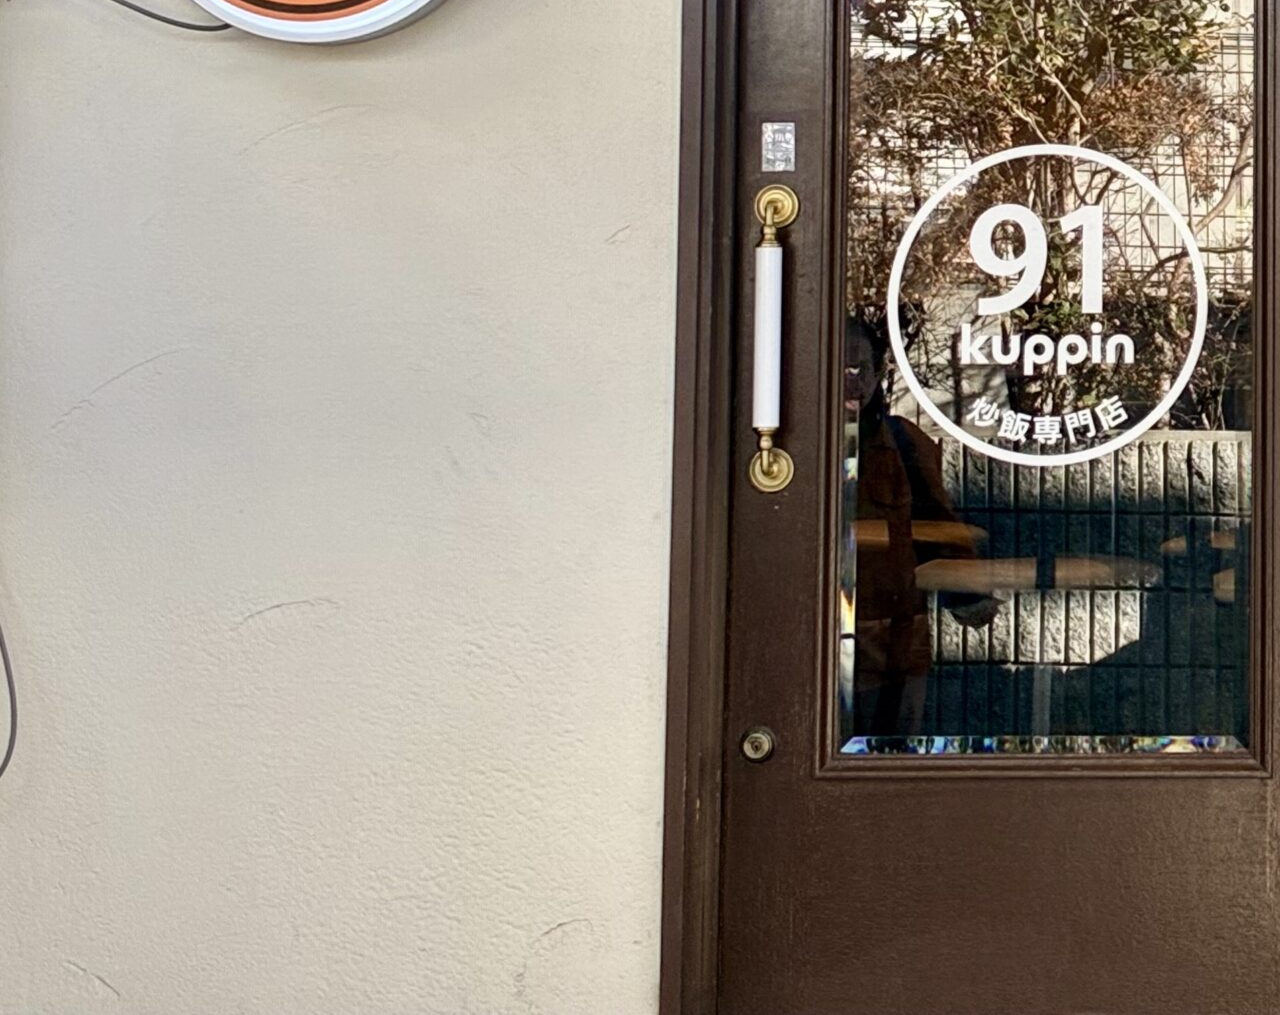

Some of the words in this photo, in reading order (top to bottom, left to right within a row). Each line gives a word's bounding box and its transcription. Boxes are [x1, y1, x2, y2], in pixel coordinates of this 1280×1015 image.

[969, 203, 1104, 317] 91
[959, 322, 1135, 376] kuppin
[965, 394, 1129, 446] 炒飯専門店
